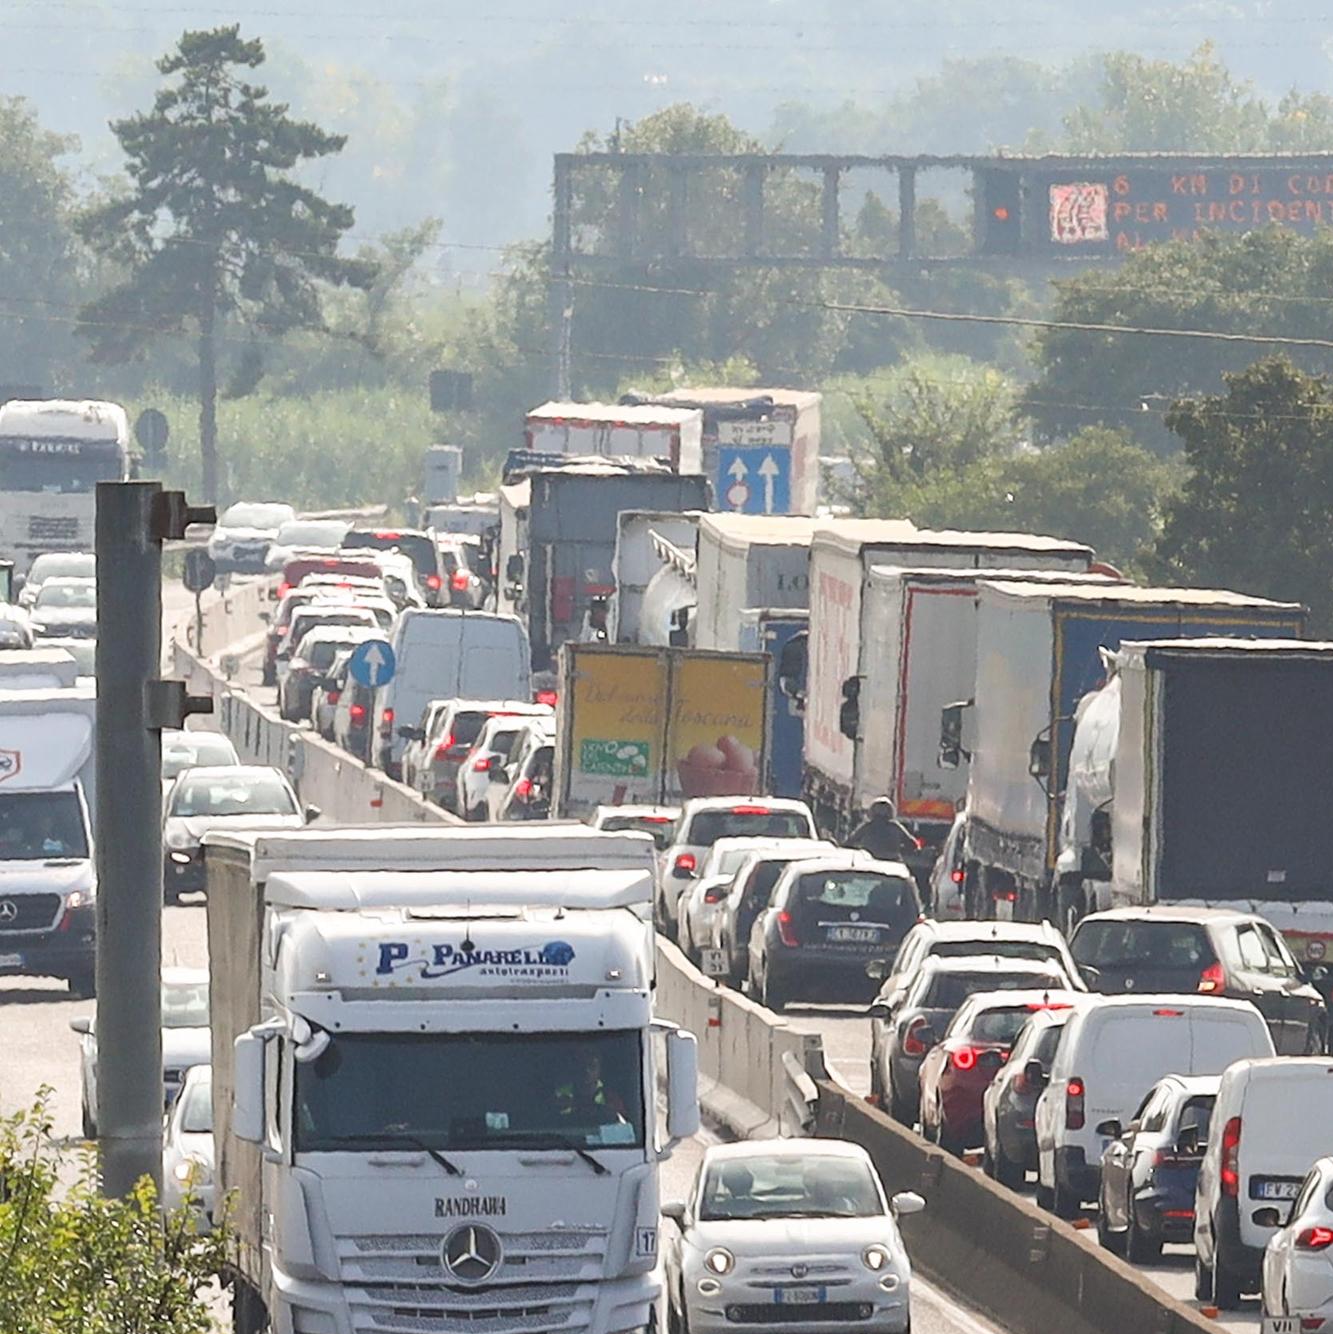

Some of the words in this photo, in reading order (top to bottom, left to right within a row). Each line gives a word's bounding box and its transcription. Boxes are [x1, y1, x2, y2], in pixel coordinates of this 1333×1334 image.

[1171, 175, 1208, 195] KM
[1229, 175, 1262, 195] DI
[1113, 202, 1168, 222] PER
[434, 1198, 506, 1217] RANDHAWA
[1273, 1321, 1292, 1331] VII
